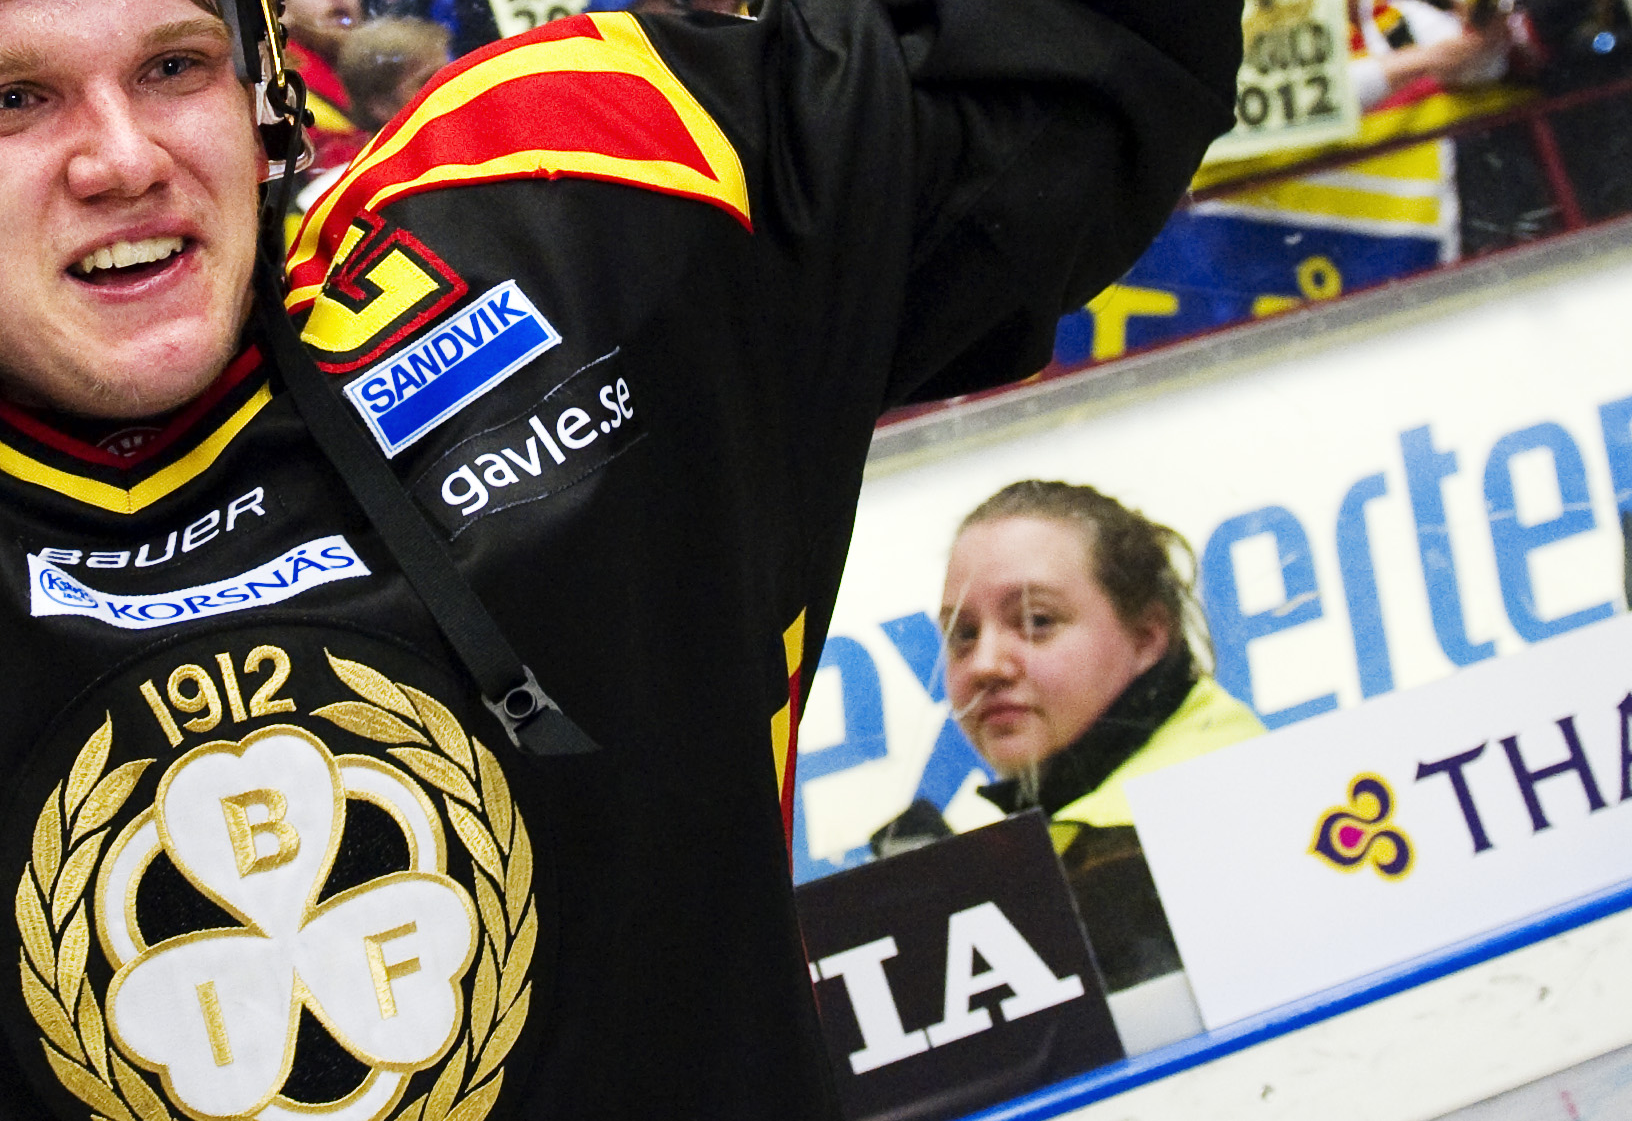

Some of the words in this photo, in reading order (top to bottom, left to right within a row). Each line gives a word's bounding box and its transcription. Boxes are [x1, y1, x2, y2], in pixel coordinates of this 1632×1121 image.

[1236, 74, 1337, 127] 012
[360, 289, 528, 415] SANDVIK
[440, 377, 634, 517] gavle.se
[104, 546, 356, 622] KORSNÄS
[139, 644, 296, 747] 1912
[1414, 687, 1632, 856] TH
[220, 788, 302, 879] B
[364, 920, 422, 1020] F
[808, 899, 1084, 1076] IA
